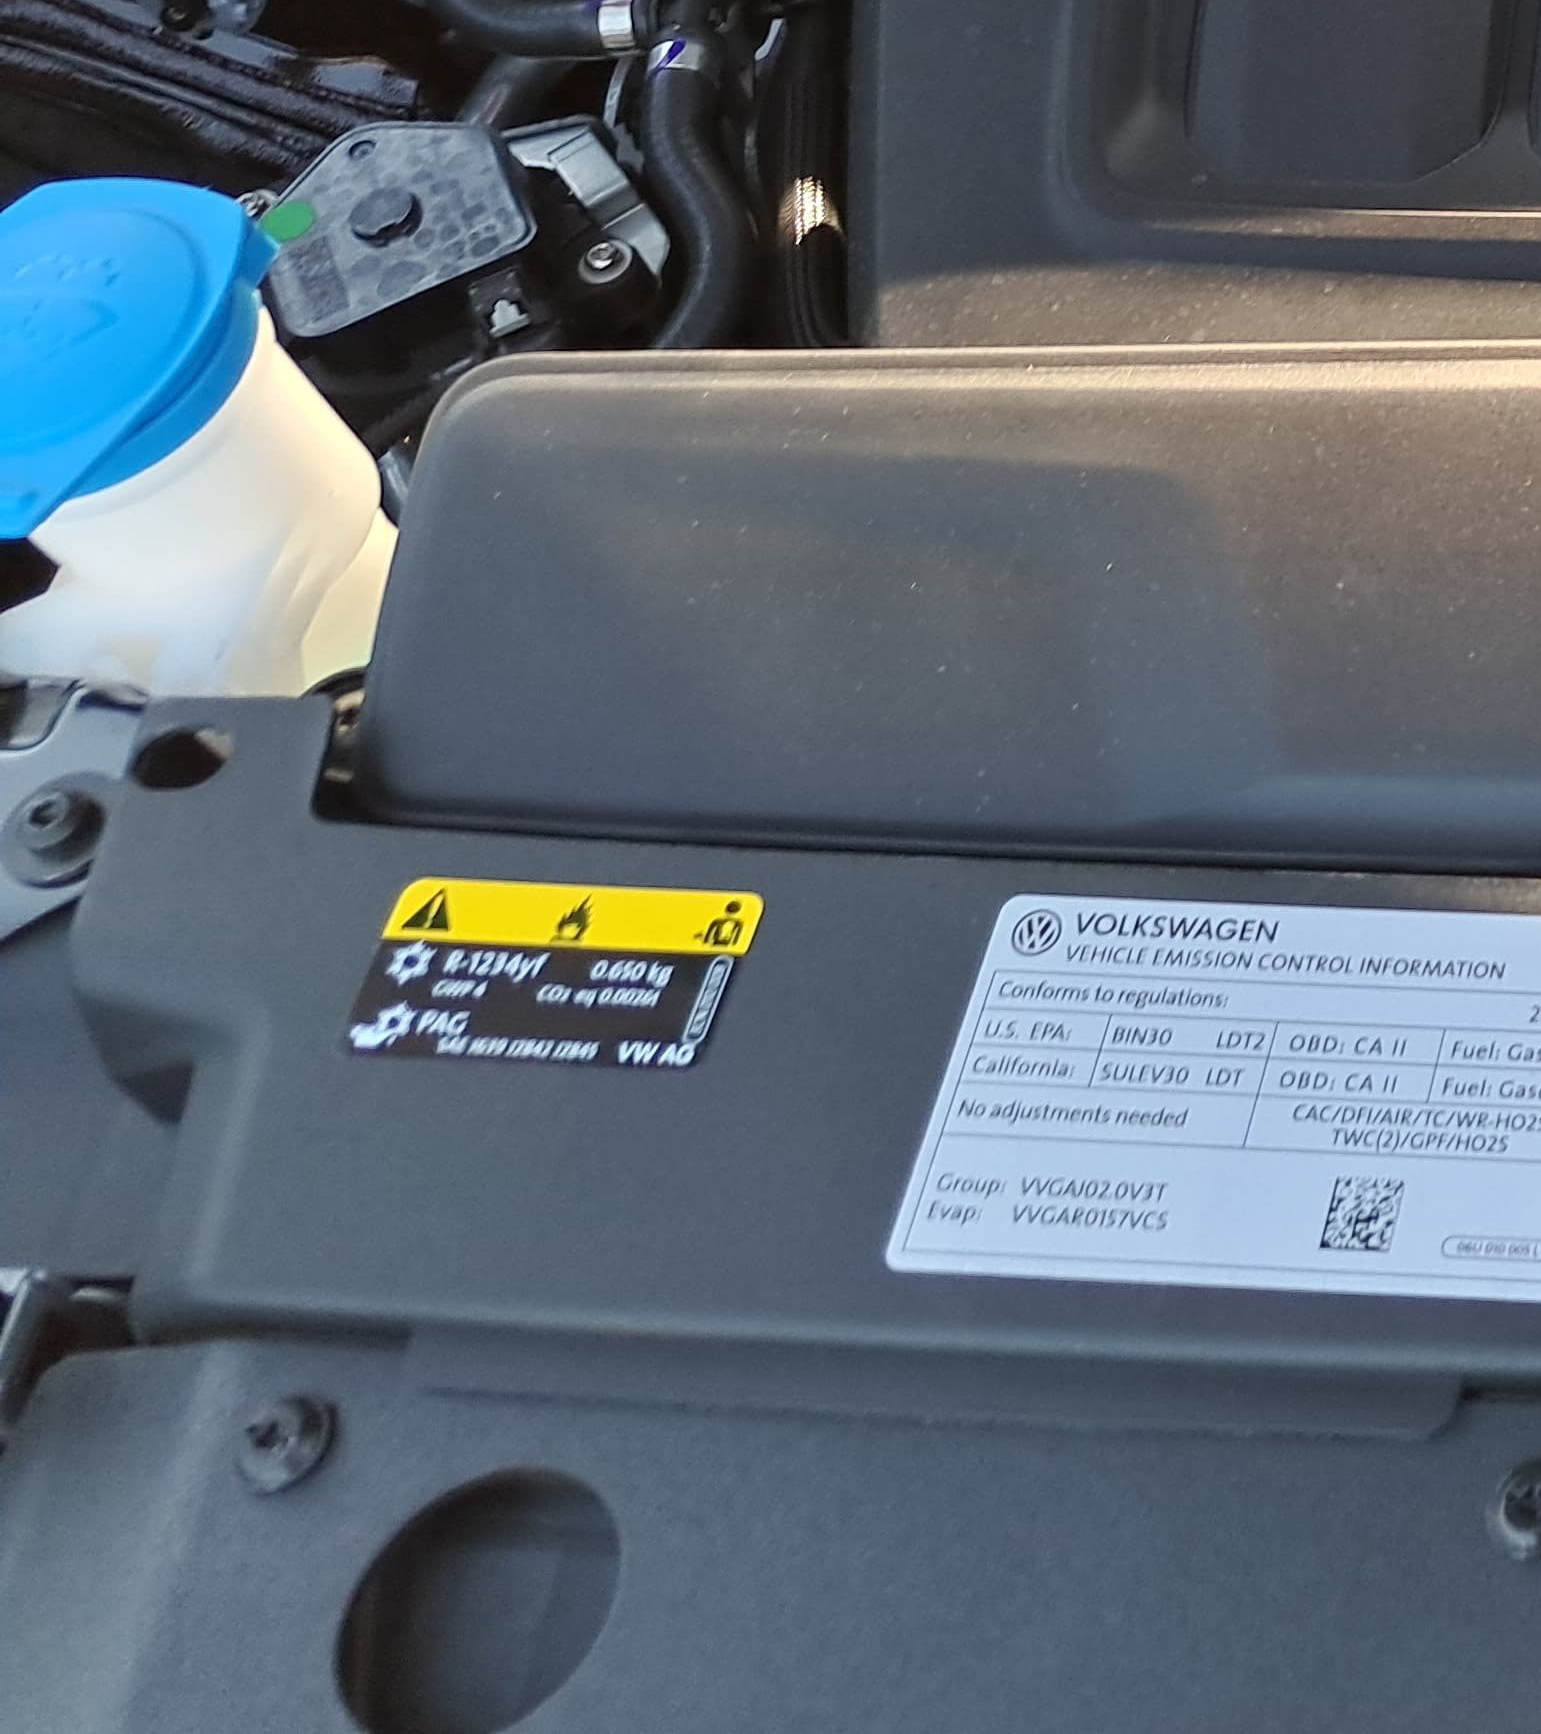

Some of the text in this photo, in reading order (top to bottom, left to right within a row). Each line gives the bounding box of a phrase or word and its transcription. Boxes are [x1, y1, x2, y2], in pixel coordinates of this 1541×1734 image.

[1077, 913, 1279, 943] VOLKSWAGEN
[443, 949, 551, 983] R-1234yf
[646, 960, 676, 989] kg
[1066, 944, 1506, 979] VEHICLE EMISSION CONTROL INFORMATION
[998, 980, 1229, 1009] Conforms to regulations:
[414, 1008, 471, 1036] PAG
[617, 1040, 660, 1066] VW
[659, 1042, 698, 1067] AG
[984, 1020, 1019, 1040] U.S.
[1029, 1021, 1072, 1041] EPA:
[1111, 1026, 1173, 1046] BIN30
[1216, 1031, 1265, 1051] LDT2
[1289, 1034, 1345, 1055] OBD:
[1353, 1036, 1383, 1056] CA
[1391, 1038, 1407, 1057] II
[1450, 1040, 1500, 1061] Fuel:
[972, 1055, 1075, 1078] California:
[1100, 1060, 1190, 1084] SULEV30
[1205, 1068, 1245, 1087] LDT
[1279, 1070, 1335, 1091] OBD:
[1344, 1073, 1373, 1093] CA
[1382, 1074, 1398, 1094] II
[1441, 1077, 1492, 1097] Fuel:
[957, 1099, 1189, 1128] No adjustments needed
[1333, 1128, 1508, 1153] TWC(2)/GPF/HO2S
[936, 1172, 1006, 1199] Group:
[926, 1200, 982, 1227] Evap:
